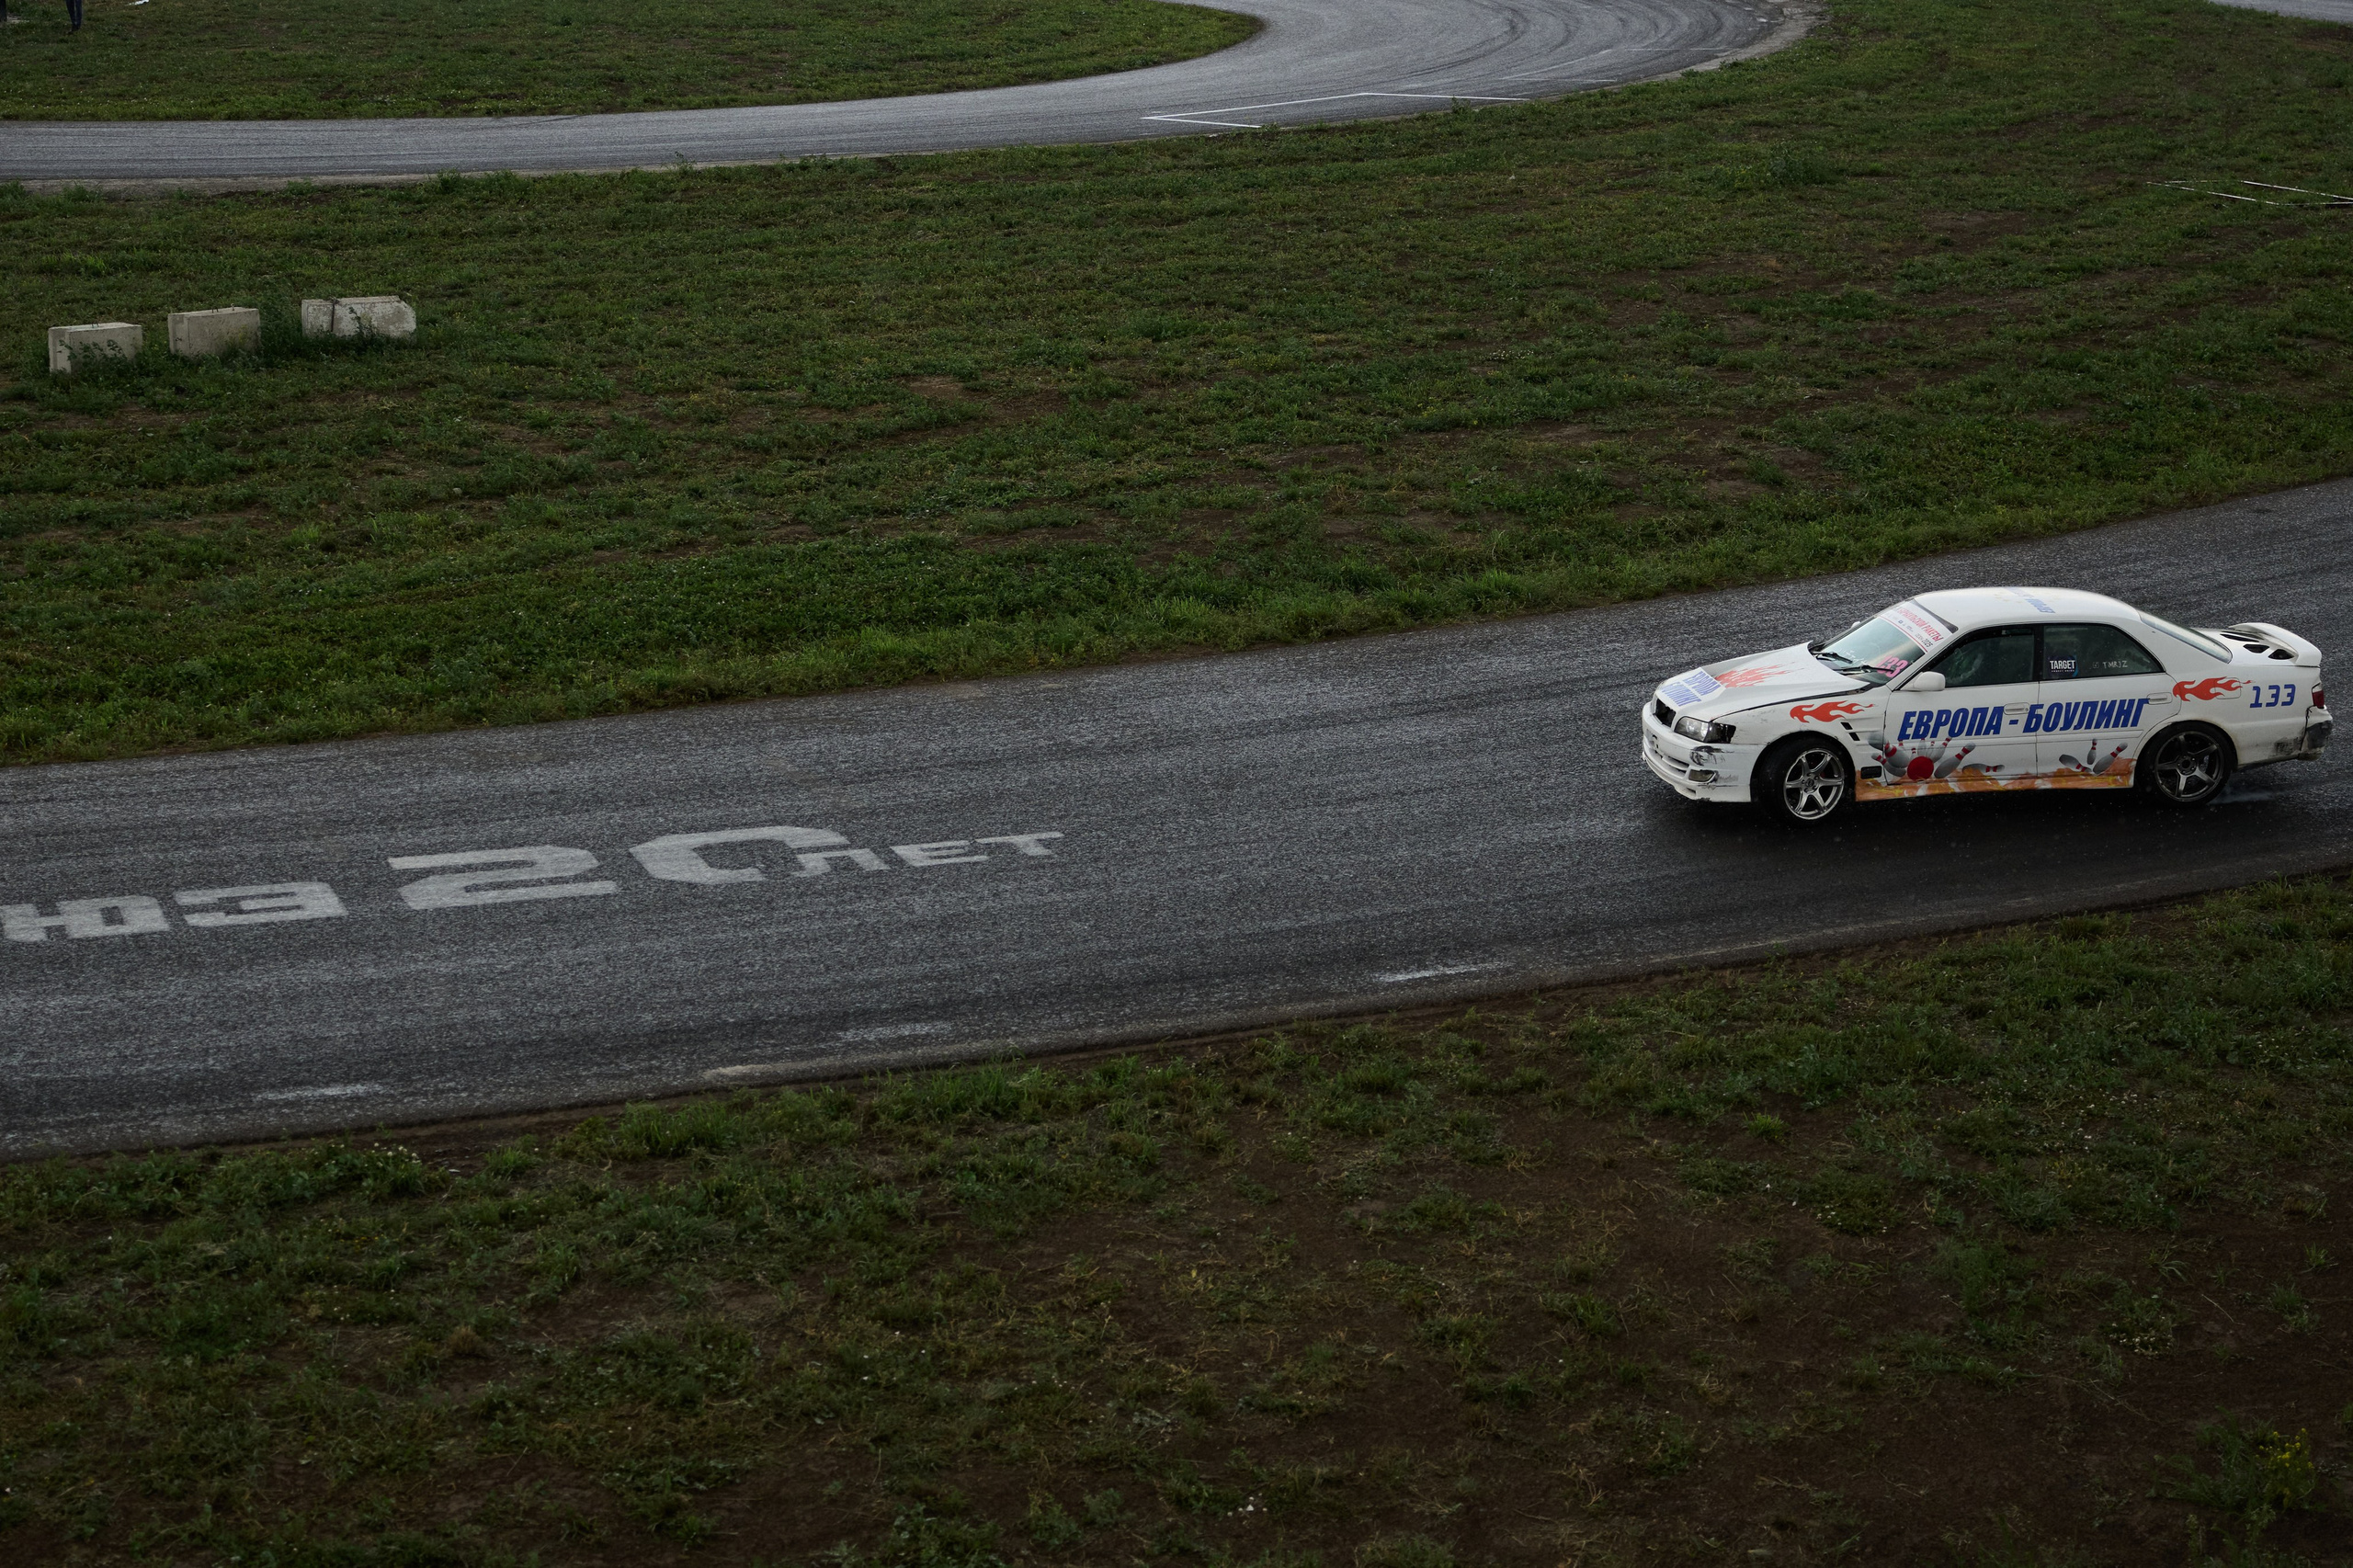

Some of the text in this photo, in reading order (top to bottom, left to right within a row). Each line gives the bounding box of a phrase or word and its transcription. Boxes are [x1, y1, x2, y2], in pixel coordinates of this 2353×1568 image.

[1876, 655, 1909, 678] 133
[2050, 660, 2075, 670] TARGET
[1682, 670, 1722, 696] ЕВРОПА
[2249, 684, 2297, 709] 133
[1897, 706, 2005, 741] ЕВРОПА
[2021, 699, 2151, 734] БОУЛИНГ
[790, 831, 1065, 880] ЛЕТ
